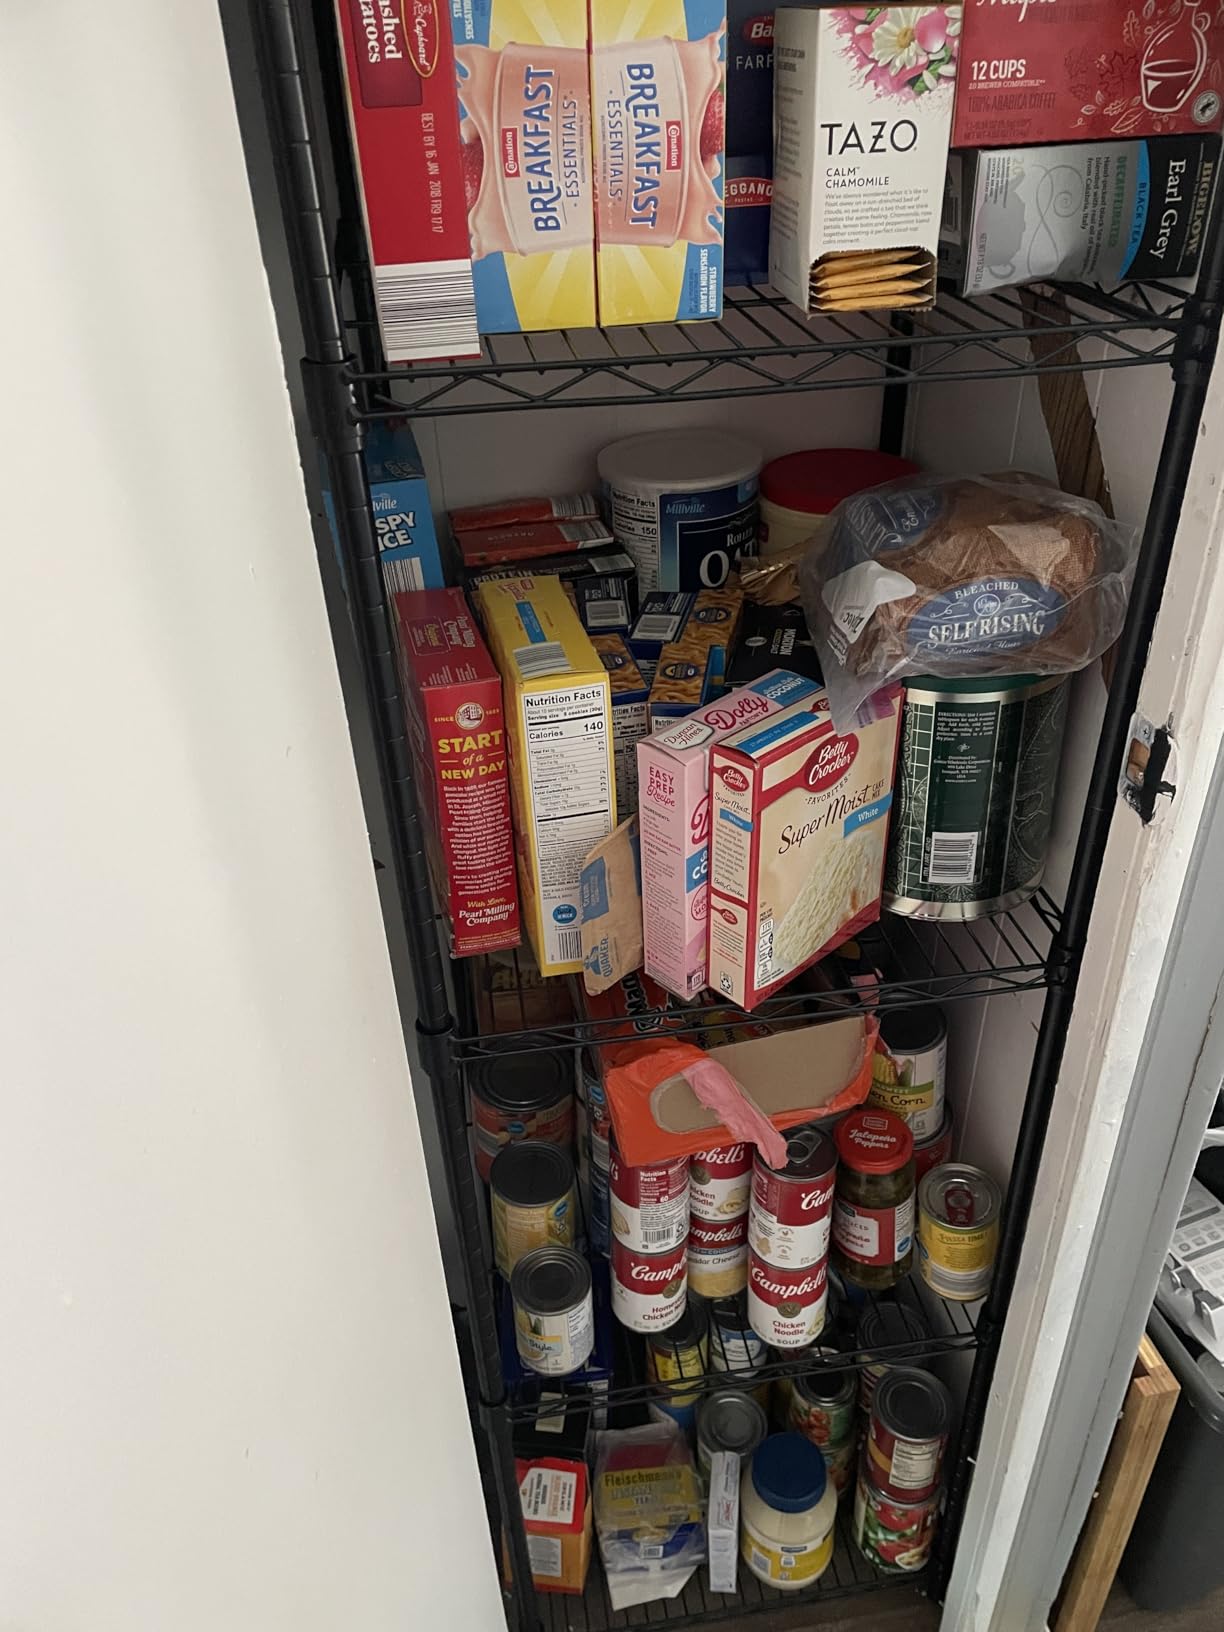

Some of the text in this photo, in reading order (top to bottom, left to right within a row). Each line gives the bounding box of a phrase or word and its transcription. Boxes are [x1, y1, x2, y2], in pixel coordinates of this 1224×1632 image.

[971, 59, 1027, 81] 12 CUPS
[992, 93, 1028, 111] ARABICA
[1028, 92, 1056, 109] COFFEE
[421, 113, 434, 132] BEST
[423, 136, 435, 146] BY
[625, 63, 662, 229] BREAKFAST
[820, 119, 918, 155] TAZO
[523, 64, 562, 231] BREAKFAST
[563, 97, 580, 198] ESSENTIALS
[607, 99, 624, 199] ESSENTIALS
[1085, 157, 1093, 177] from
[1093, 157, 1101, 189] blended
[825, 176, 889, 188] CHAMOMILE
[1091, 191, 1099, 208] with
[1150, 159, 1187, 259] Earl Grey
[1186, 160, 1214, 255] BIGELOW
[1080, 213, 1090, 230] Italy
[1098, 207, 1107, 227] black
[1131, 182, 1147, 244] BLACK TEA
[700, 248, 708, 313] SENSATION FLAVOR
[709, 266, 717, 313] STRAWBERRY
[636, 498, 655, 507] Facts
[641, 527, 657, 535] 150
[954, 581, 1019, 600] BLEACHED
[843, 612, 865, 633] Ziploc
[928, 609, 1046, 649] SELF RISING
[779, 628, 797, 656] MORTON
[766, 677, 806, 700] COCONUT
[526, 690, 602, 708] Nutrition Facts
[704, 696, 768, 730] Dolly
[529, 721, 604, 740] Calories 140
[663, 722, 697, 744] Duncan
[679, 728, 703, 745] Hines
[438, 730, 503, 754] START
[462, 753, 485, 766] of a
[818, 741, 848, 766] Betty
[441, 760, 505, 780] NEW DAY
[649, 766, 675, 785] EASY
[727, 769, 744, 783] Betty
[808, 753, 851, 785] Crocker
[650, 777, 675, 795] PREP
[807, 777, 849, 805] FAVORITES
[871, 789, 881, 800] MIX
[872, 779, 885, 791] CAKE
[647, 784, 676, 807] Recipe
[858, 807, 879, 822] White
[458, 902, 516, 919] Pearl Milling
[466, 912, 509, 927] Company
[762, 921, 772, 931] 170
[600, 938, 613, 977] QUAKER
[890, 1094, 926, 1106] Corn
[639, 1169, 667, 1178] Nutrition
[660, 1195, 669, 1203] 60
[712, 1252, 740, 1266] Cheese
[751, 1262, 827, 1299] Campbell's
[642, 1307, 674, 1321] Chicken
[772, 1319, 806, 1330] Chicken
[774, 1327, 805, 1337] Noodle
[777, 1337, 801, 1345] SOUP
